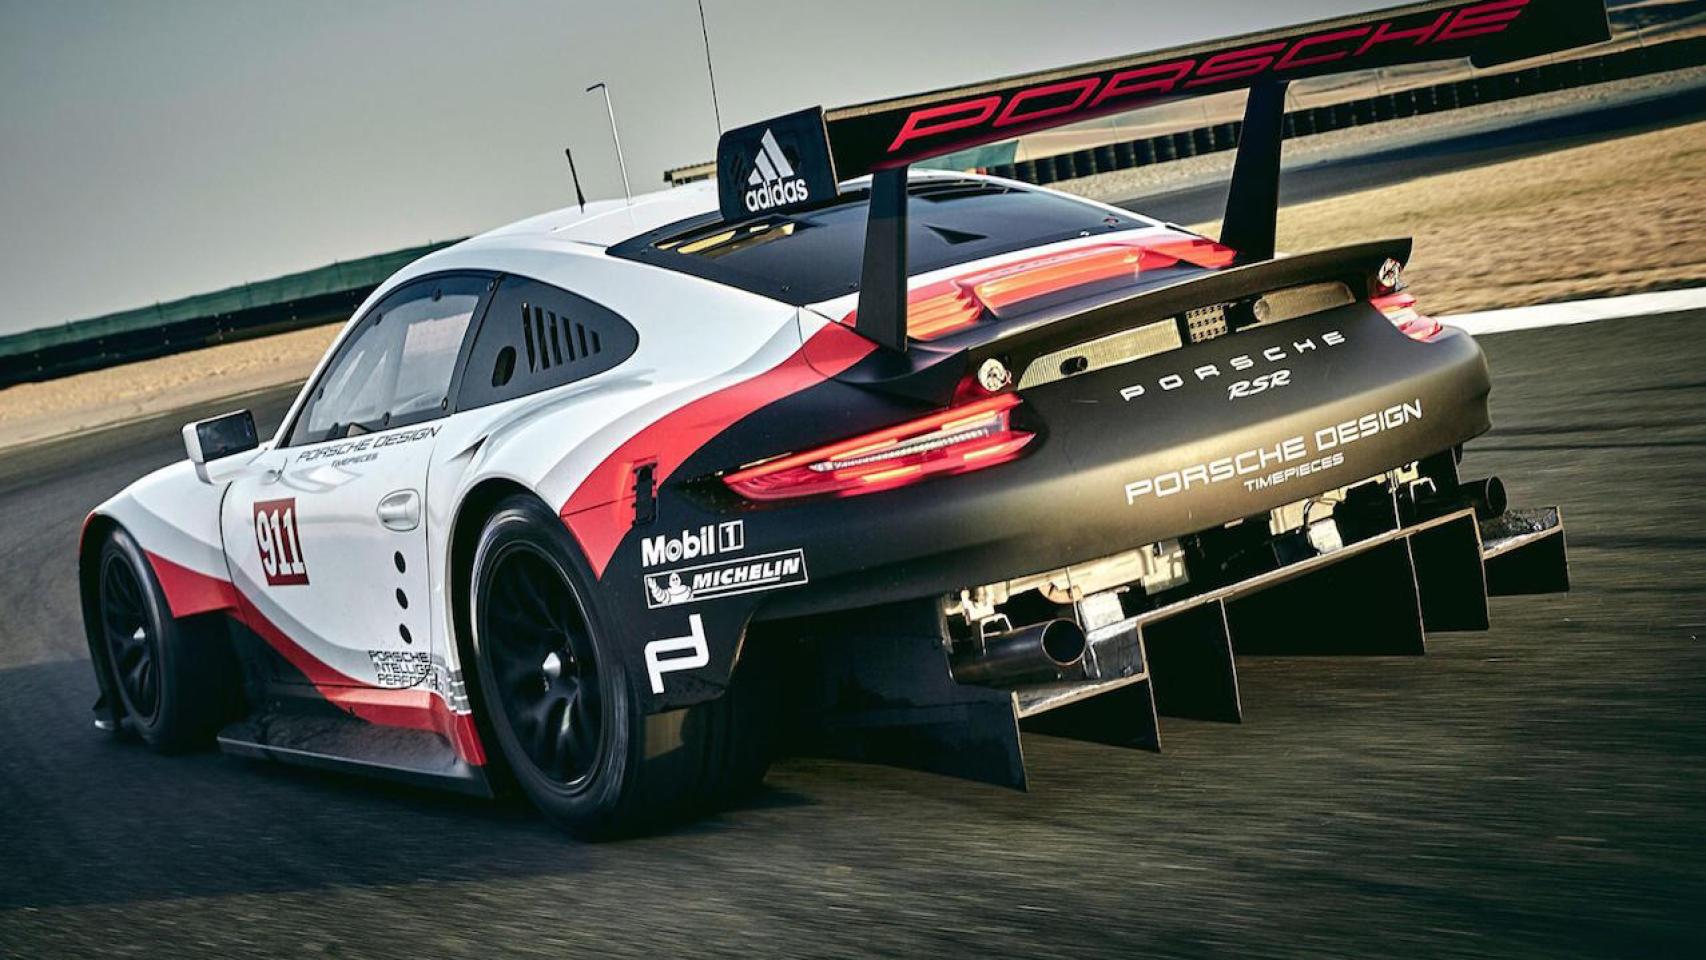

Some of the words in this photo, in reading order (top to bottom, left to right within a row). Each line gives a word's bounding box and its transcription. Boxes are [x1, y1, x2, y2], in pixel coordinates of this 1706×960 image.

[887, 0, 1531, 152] PORSCHE
[745, 178, 809, 212] adidas
[1120, 331, 1346, 402] PORSCHE
[1228, 369, 1292, 400] RSR
[296, 438, 374, 463] PORSCHE
[373, 424, 443, 449] DESIGN
[1124, 436, 1308, 506] PORSCHE
[1315, 399, 1424, 452] DESIGN
[1244, 452, 1345, 493] TIMEPIECES
[256, 508, 306, 577] 911
[641, 525, 716, 567] Mobil
[693, 557, 800, 590] MICHELIN
[368, 650, 429, 662] PORSCHE
